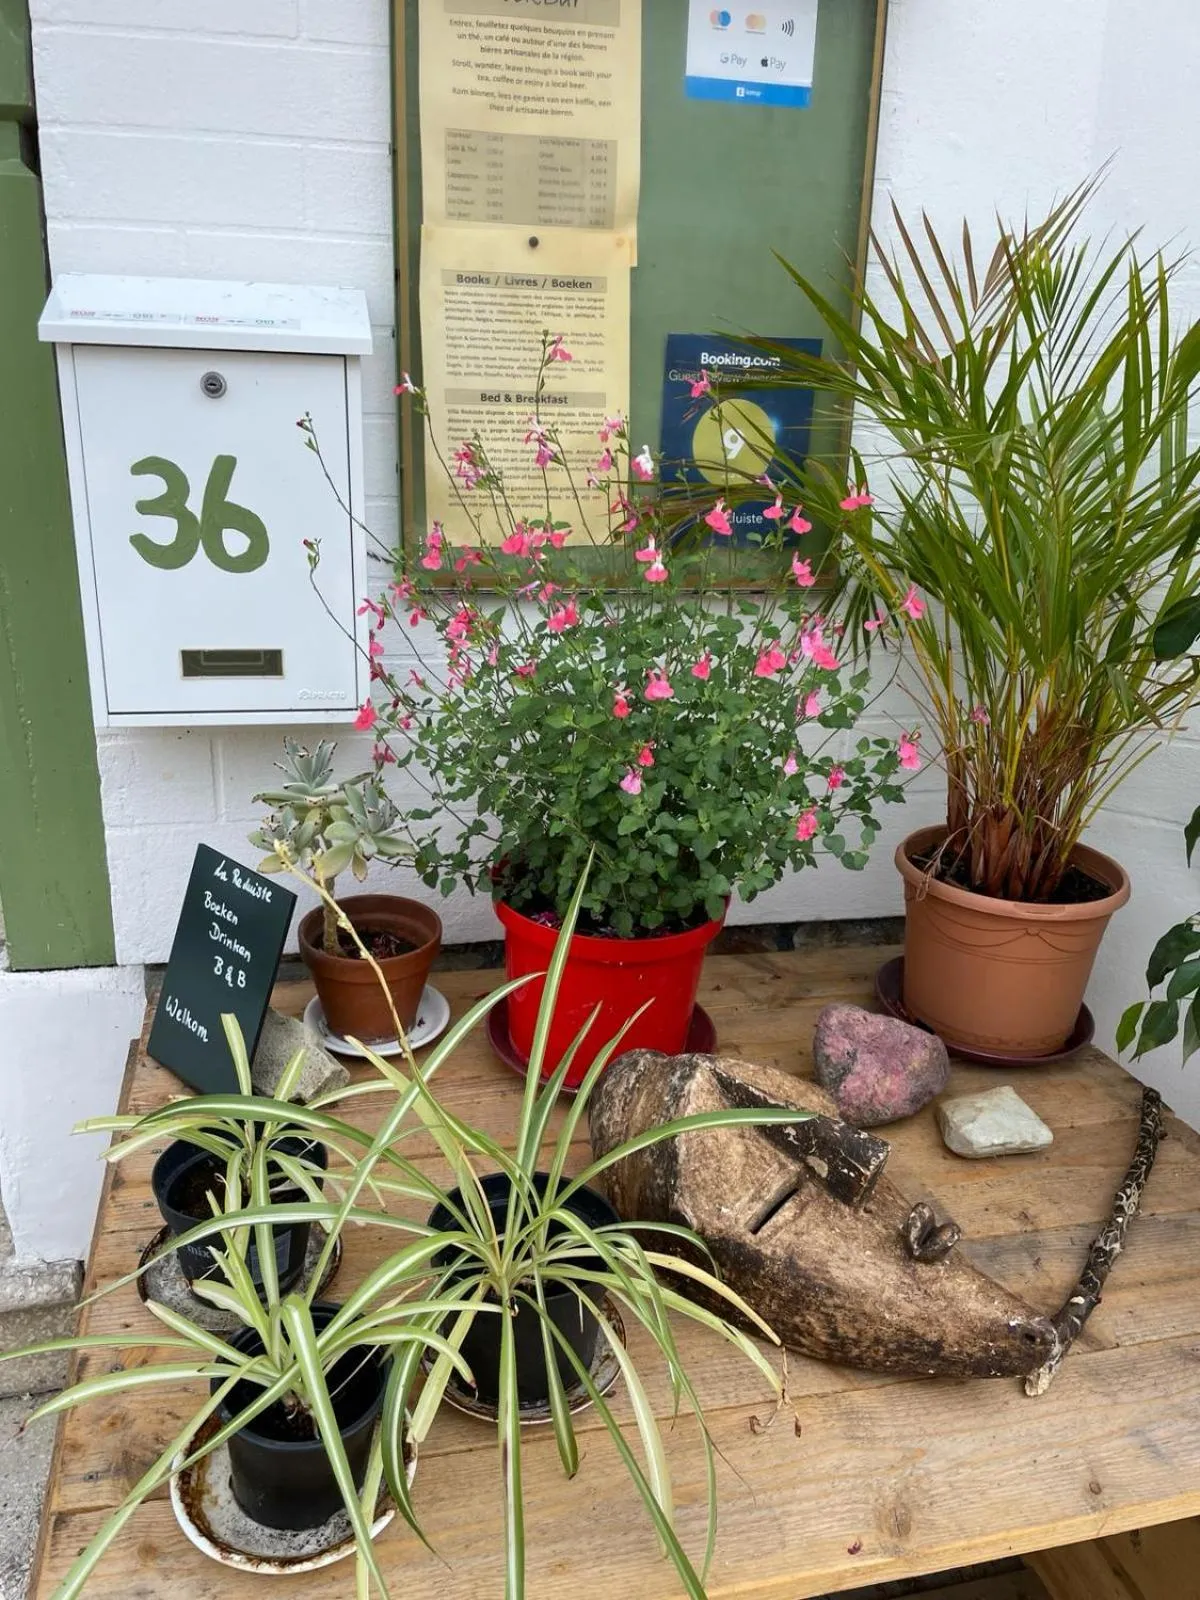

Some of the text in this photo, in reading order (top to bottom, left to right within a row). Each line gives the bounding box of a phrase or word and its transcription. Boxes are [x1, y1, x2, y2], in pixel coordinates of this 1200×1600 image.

[456, 274, 491, 284] Books
[494, 276, 500, 286] /
[504, 276, 538, 287] Livres
[552, 278, 592, 290] Boeken
[700, 352, 780, 368] Booking.com
[480, 392, 568, 404] Bed & Breakfast
[722, 428, 745, 460] 9
[129, 454, 270, 574] 36
[727, 511, 764, 524] duiste
[213, 860, 272, 903] La Reduiste
[204, 890, 238, 926] Boeken
[208, 922, 251, 964] Drinken
[213, 956, 246, 988] B & B
[165, 995, 208, 1044] Welkom
